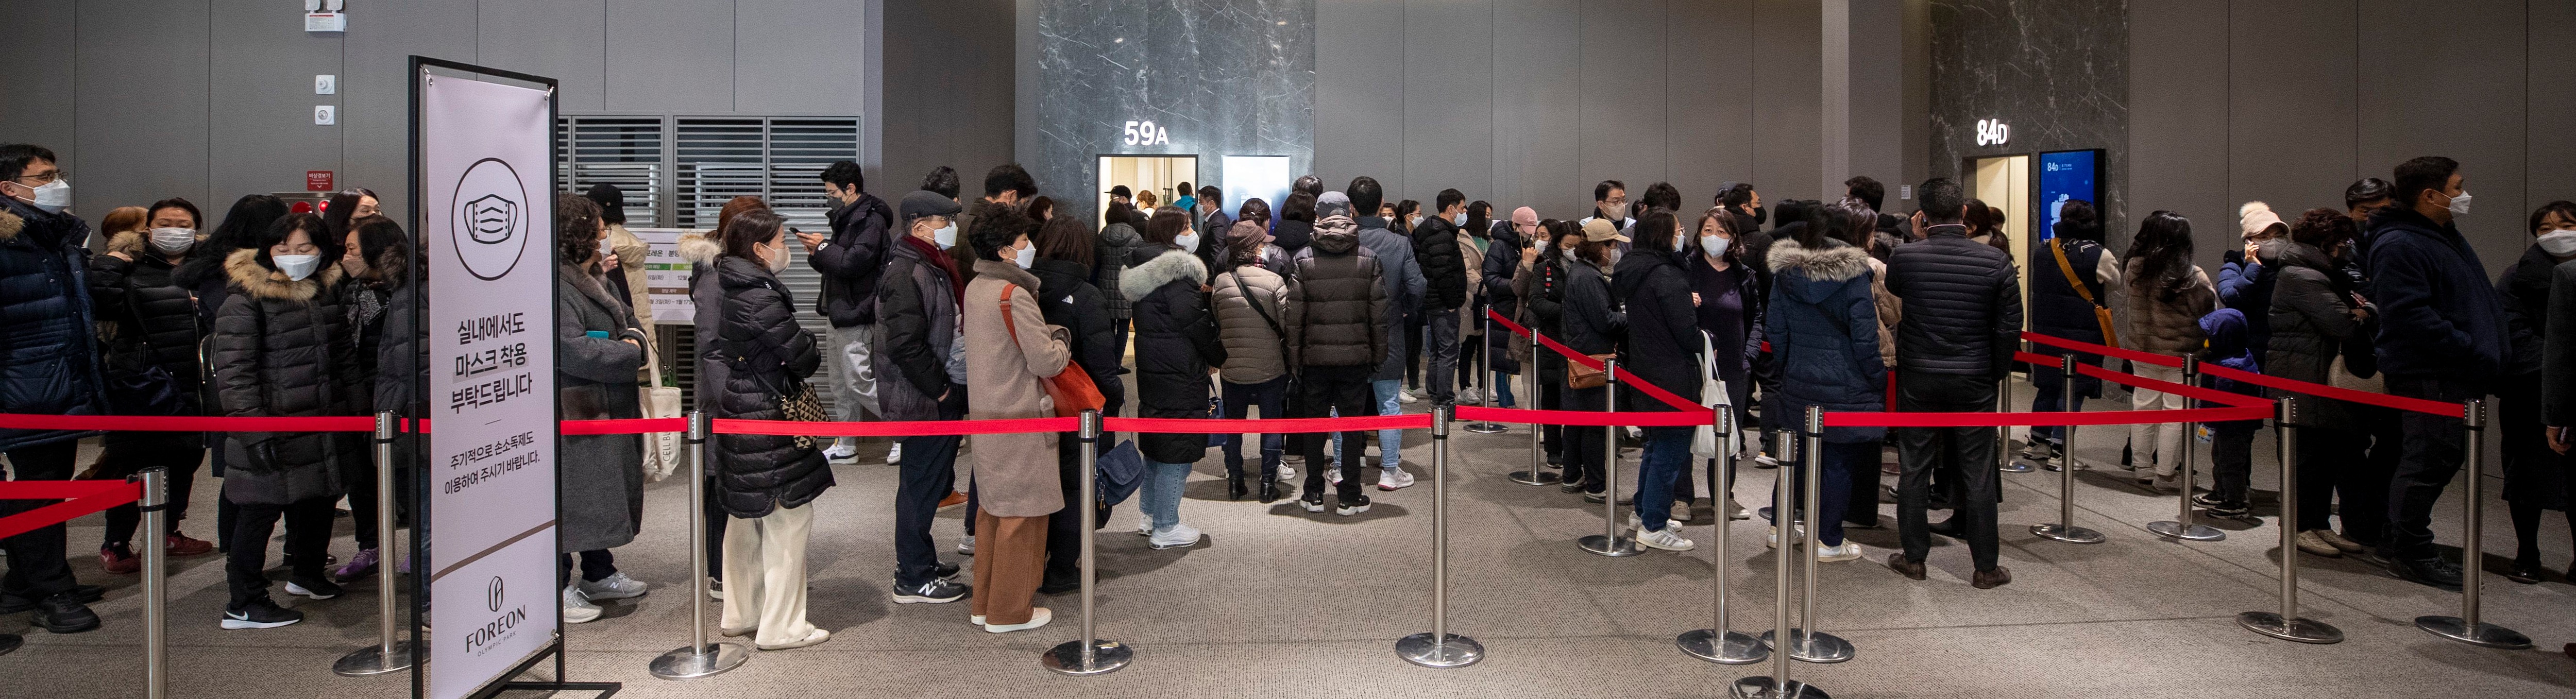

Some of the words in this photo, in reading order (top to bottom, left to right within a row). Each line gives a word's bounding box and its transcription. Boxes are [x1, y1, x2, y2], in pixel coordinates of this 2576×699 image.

[1124, 121, 1169, 146] 59A
[1976, 118, 2008, 146] 84D
[2047, 162, 2059, 172] 84D
[457, 312, 525, 345] 실내에서도
[456, 349, 498, 377] 마스크
[501, 343, 527, 367] 착용
[451, 372, 532, 414] 부탁드립니다
[450, 444, 493, 470] 주기적으로
[495, 431, 534, 455] 손소독제도
[663, 442, 671, 462] CELL
[445, 470, 479, 495] 이용하여
[480, 461, 505, 482] 주시기
[506, 450, 540, 471] 바랍니다.
[466, 604, 526, 653] FOREON
[478, 639, 501, 657] OLYMPIC
[503, 630, 516, 641] PARK
